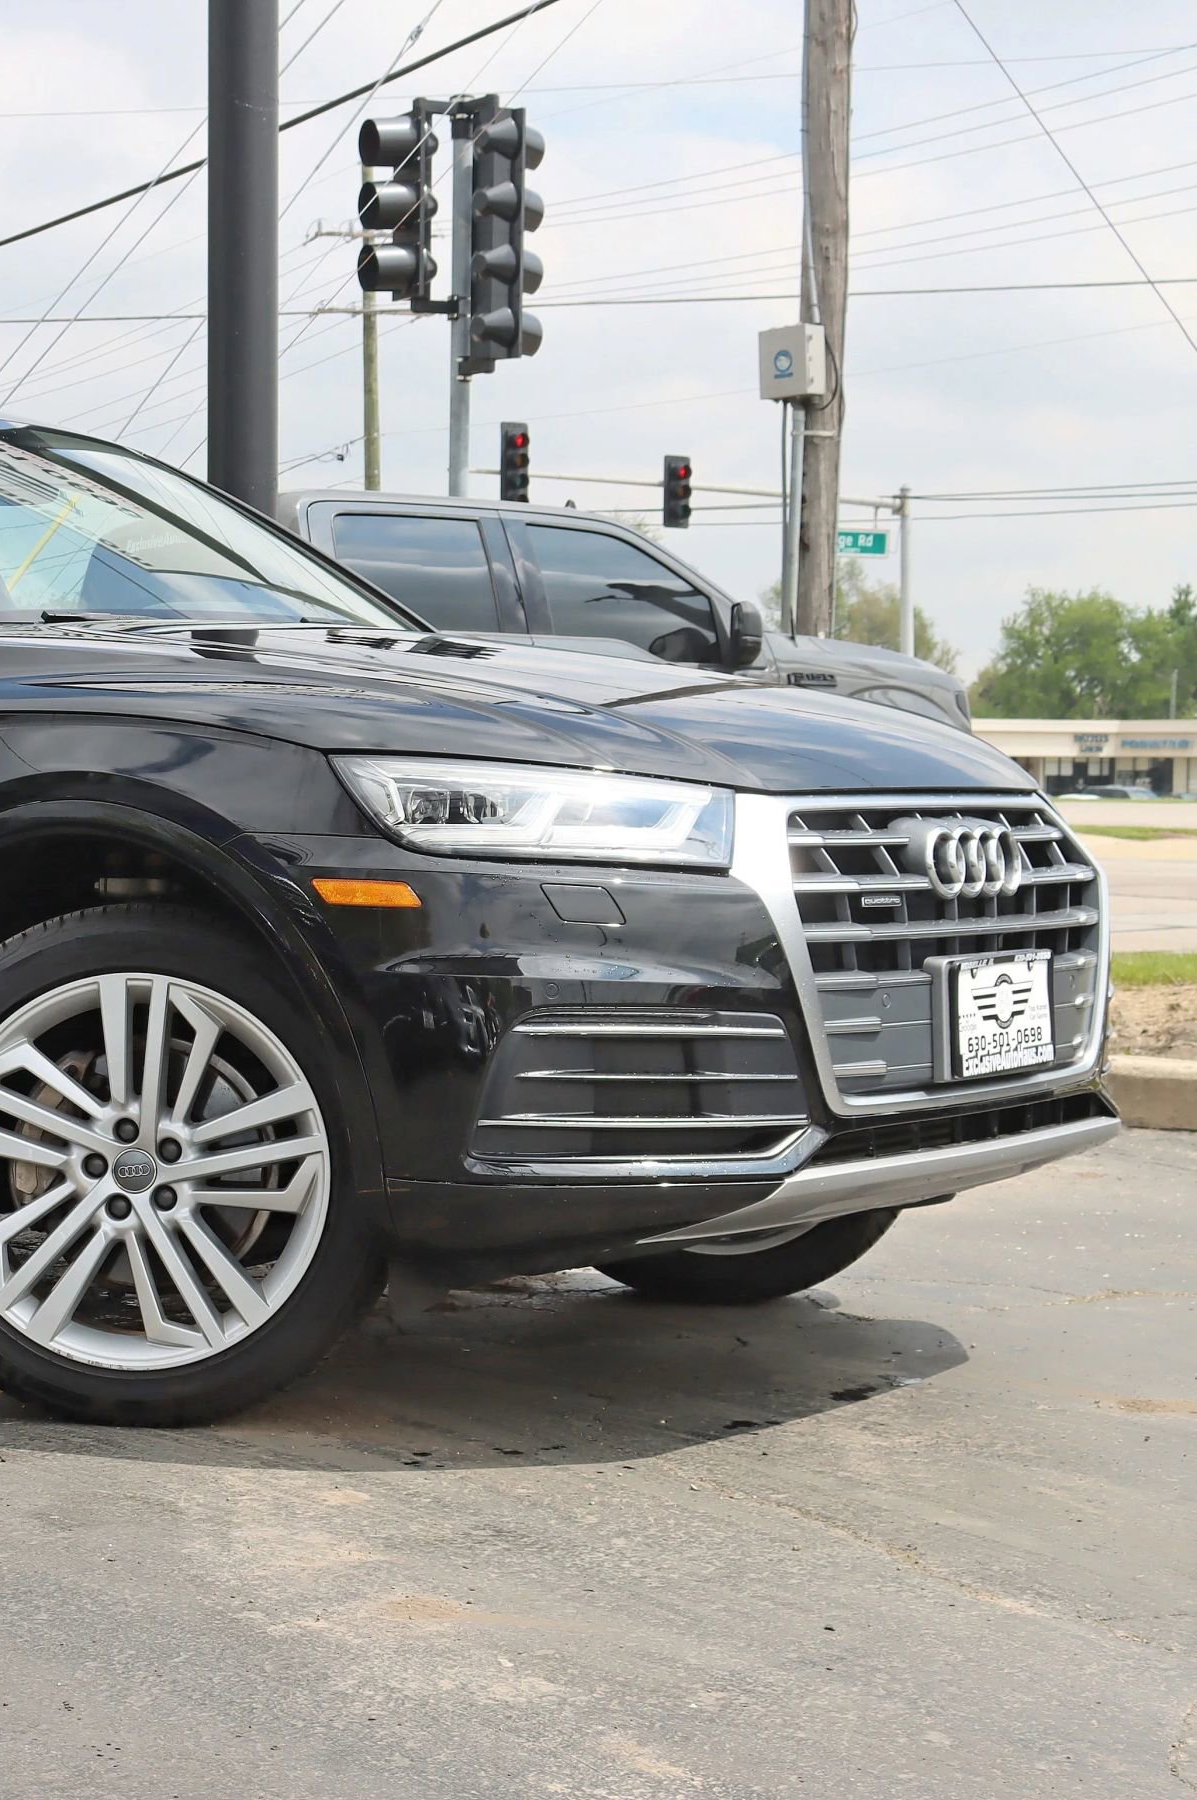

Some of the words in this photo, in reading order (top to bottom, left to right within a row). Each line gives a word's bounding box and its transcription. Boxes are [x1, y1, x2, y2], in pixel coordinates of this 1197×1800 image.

[857, 533, 874, 547] Rd
[967, 1026, 1043, 1053] 630-501-0698
[962, 1043, 1054, 1077] ExclusiveAutoHaus.com
